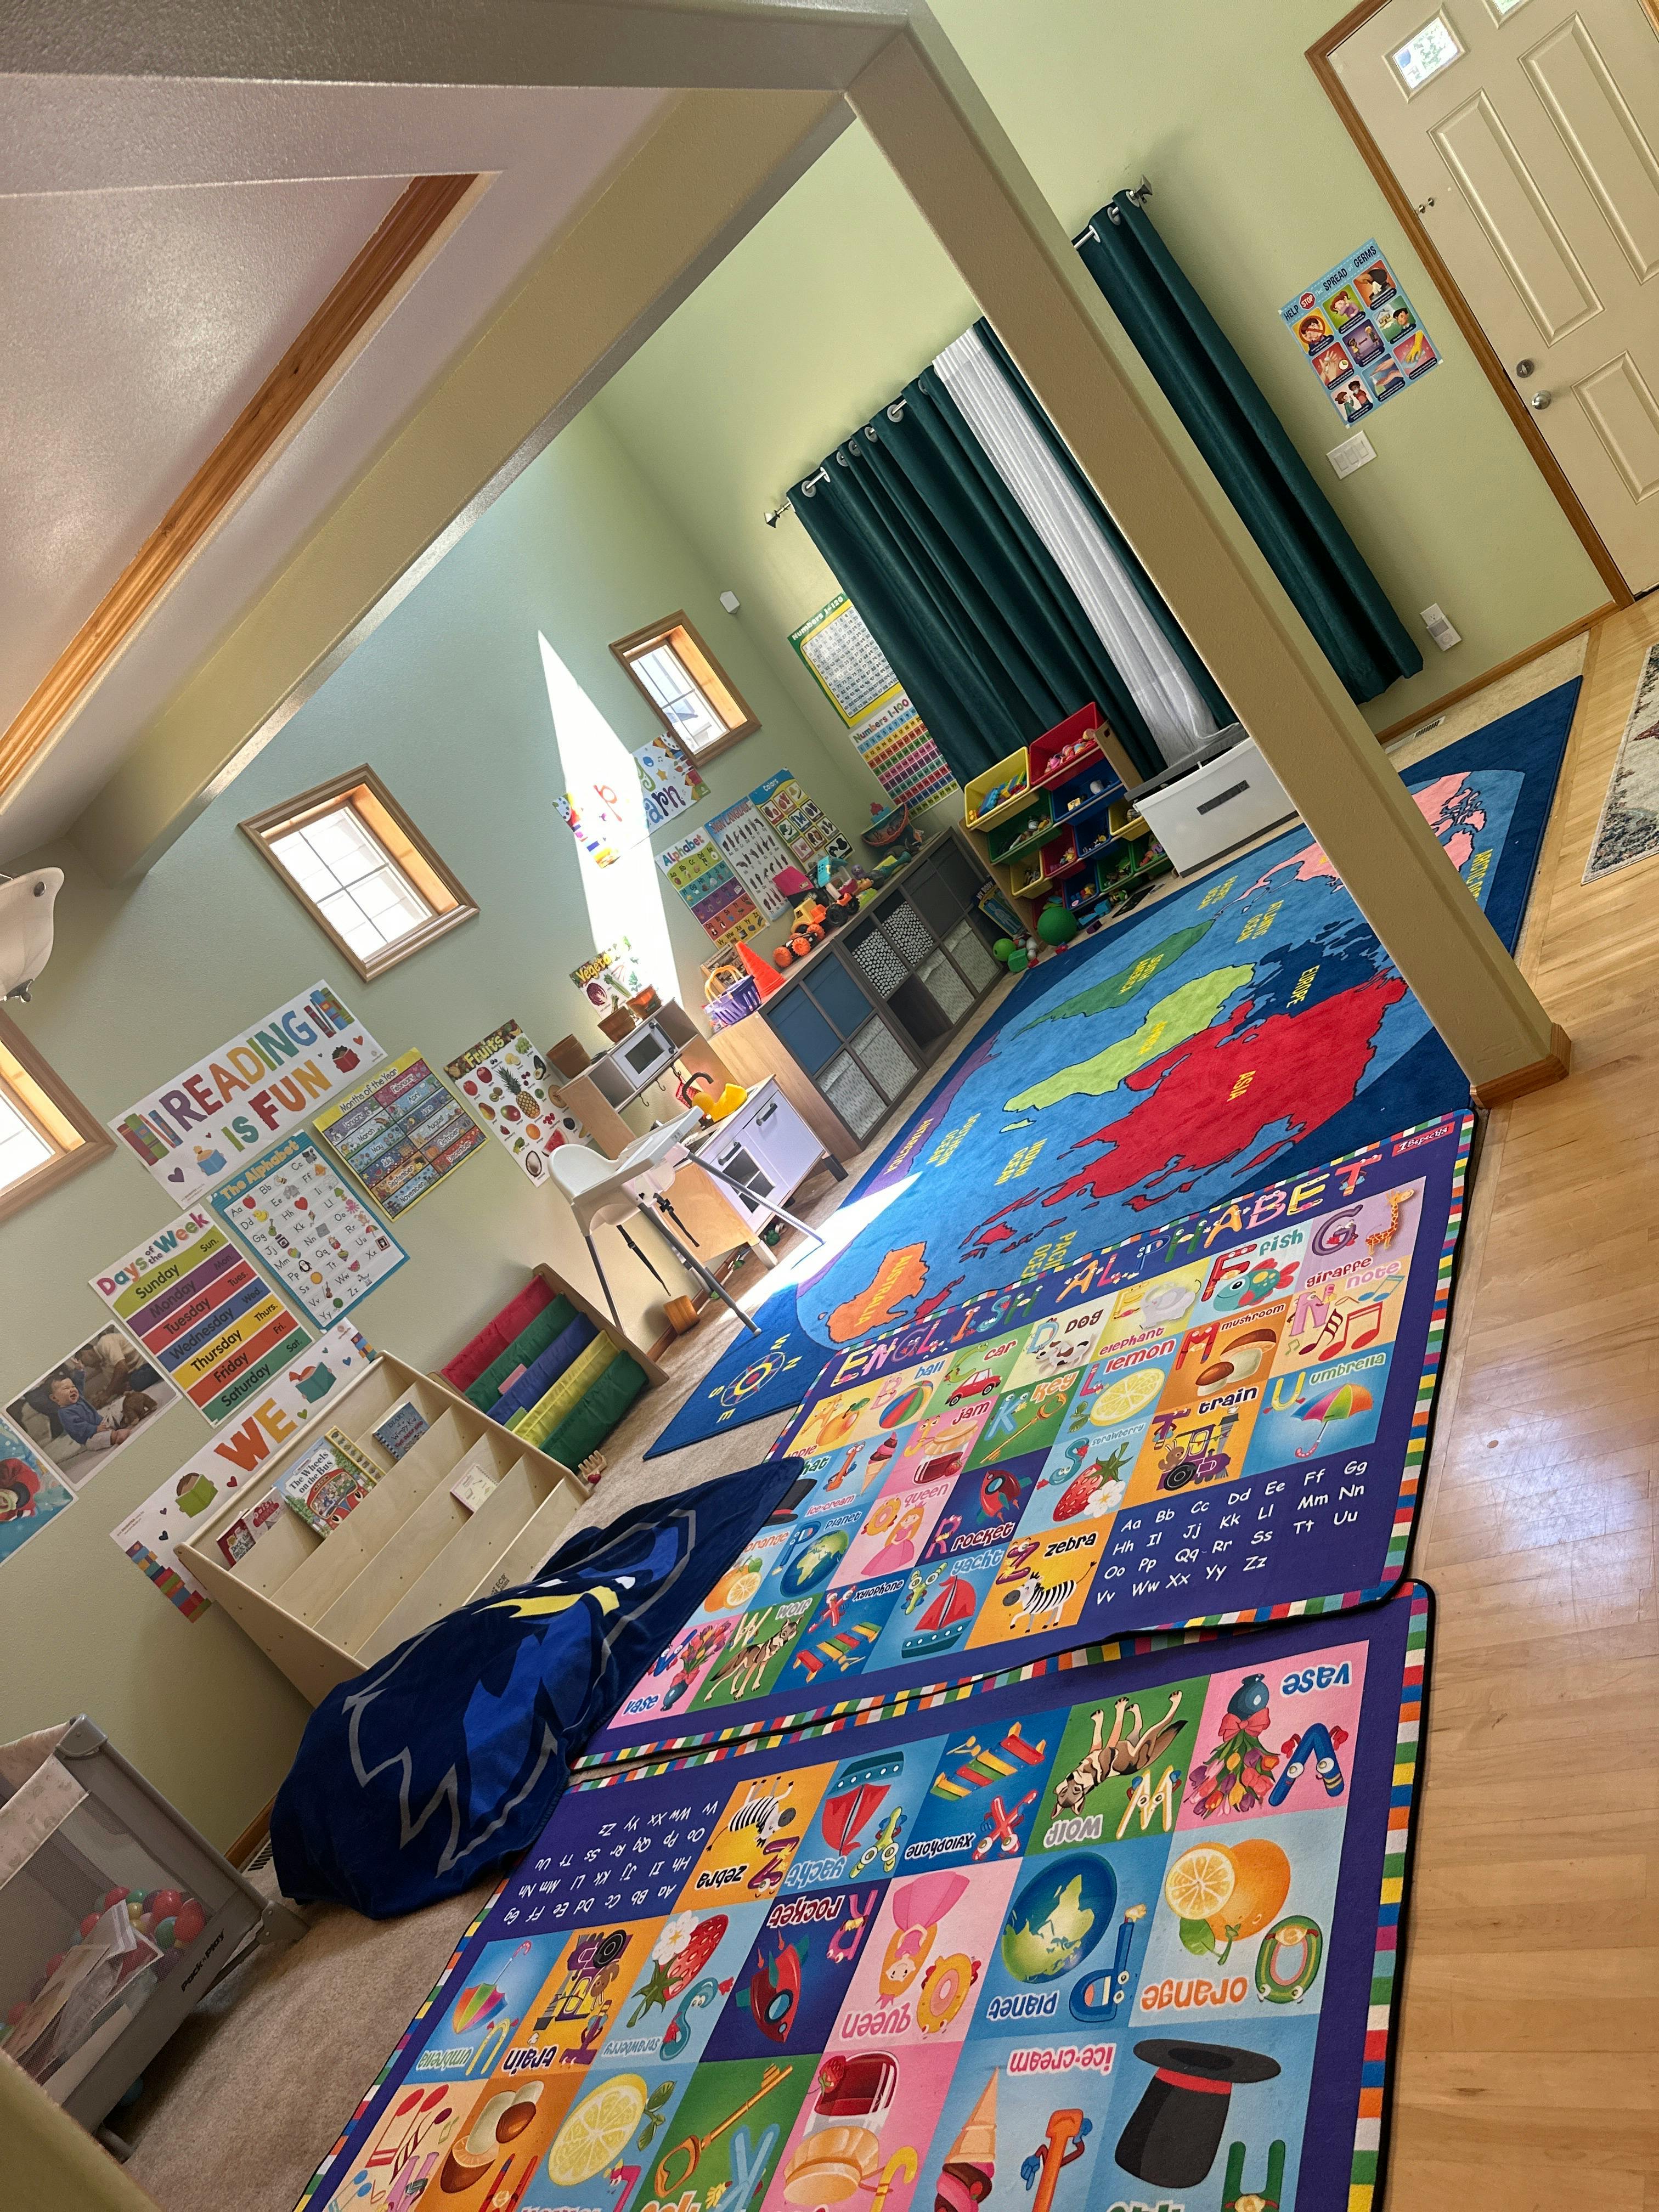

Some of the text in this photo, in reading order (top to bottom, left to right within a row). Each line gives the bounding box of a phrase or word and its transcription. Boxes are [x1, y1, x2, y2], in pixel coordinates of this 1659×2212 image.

[1284, 304, 1299, 321] HELP
[1301, 295, 1313, 308] STOP
[1323, 268, 1348, 291] SPREAD
[1353, 246, 1376, 268] GERMS
[792, 612, 824, 641] Numbers
[853, 699, 909, 743] Numbers 1-100
[763, 778, 779, 792] Colors
[710, 800, 752, 834] SIGN LANGUAGE
[662, 834, 705, 866] Alphabet
[1466, 848, 1493, 885] ARCTIC
[1285, 964, 1321, 1008] EUROPE
[464, 1034, 505, 1068] Fruits
[159, 1010, 318, 1132] READING
[1226, 1070, 1256, 1103] ASIA
[221, 1059, 332, 1152] IS FUN
[339, 1068, 398, 1114] Months of the Year
[343, 1074, 415, 1131] January February
[358, 1090, 421, 1143] March April
[371, 1104, 433, 1155] May June
[382, 1115, 444, 1168] July August
[883, 1118, 934, 1175] ANTARCTICA
[925, 1128, 960, 1165] OCEAN
[935, 1112, 981, 1167] SOUTHERN
[219, 1139, 300, 1200] The Alphabet
[388, 1128, 459, 1189] September October
[399, 1141, 472, 1204] November December
[994, 1147, 1029, 1186] OCEAN
[1012, 1138, 1048, 1179] INDIAN
[97, 1212, 211, 1296] Days of the Week
[1260, 1229, 1303, 1256] fish
[135, 1237, 219, 1299] Sunday Sun.
[830, 1154, 1383, 1387] ENGLISH ALPHABET
[1306, 1257, 1371, 1288] giraffe
[1346, 1263, 1400, 1289] note
[149, 1280, 197, 1318] Monday
[163, 1271, 249, 1335] Tuesday Tues.
[854, 1254, 913, 1327] AUSTRALIA
[170, 1287, 263, 1360] Wednesday Wed.
[1221, 1304, 1284, 1330] mushroom
[190, 1303, 278, 1372] Thursday Thurs.
[213, 1323, 286, 1385] Friday Fri.
[985, 1340, 1015, 1361] car
[1099, 1327, 1164, 1356] elephant
[221, 1338, 302, 1407] Saturday Sat.
[915, 1361, 944, 1380] ball
[1107, 1340, 1175, 1374] lemon
[1311, 1353, 1385, 1385] umbrella
[1032, 1374, 1077, 1401] key
[1199, 1387, 1257, 1415] train
[952, 1401, 990, 1425] jam
[214, 1397, 298, 1472] WE
[1092, 1424, 1145, 1447] strawberry
[289, 1477, 303, 1489] The
[301, 1452, 329, 1477] Wheels
[299, 1483, 309, 1493] on
[308, 1474, 318, 1485] the
[316, 1461, 333, 1475] Bus
[905, 1482, 949, 1508] queen
[1121, 1461, 1367, 1532] Aa Bb Cc Dd Ee Ff Gg
[826, 1512, 862, 1531] planet
[1113, 1485, 1364, 1555] Hh Jj Kk Ll Mm Nn
[743, 1532, 789, 1553] orange
[952, 1523, 1014, 1551] rocket
[1045, 1533, 1097, 1558] zebra
[1104, 1511, 1357, 1579] Oo Pp Qq Rr Ss Tt Uu
[952, 1551, 1005, 1575] yacht
[495, 1574, 507, 1588] ECR
[854, 1581, 904, 1601] xylophone
[1097, 1556, 1267, 1604] Vv Ww Xx Yy Zz
[777, 1599, 812, 1619] wolf
[1282, 1663, 1351, 1696] vase
[623, 1695, 658, 1715] vase
[905, 1833, 974, 1860] xylophone
[1045, 1815, 1101, 1848] wolf
[696, 1865, 747, 1891] zebra
[785, 1856, 845, 1888] yacht
[768, 1897, 844, 1928] rocket
[988, 1993, 1058, 2021] planet
[1141, 1978, 1248, 2011] orange
[842, 2010, 911, 2039] queen
[417, 2049, 471, 2072] umbrella
[504, 2046, 555, 2073] train
[603, 2037, 661, 2057] strawberry
